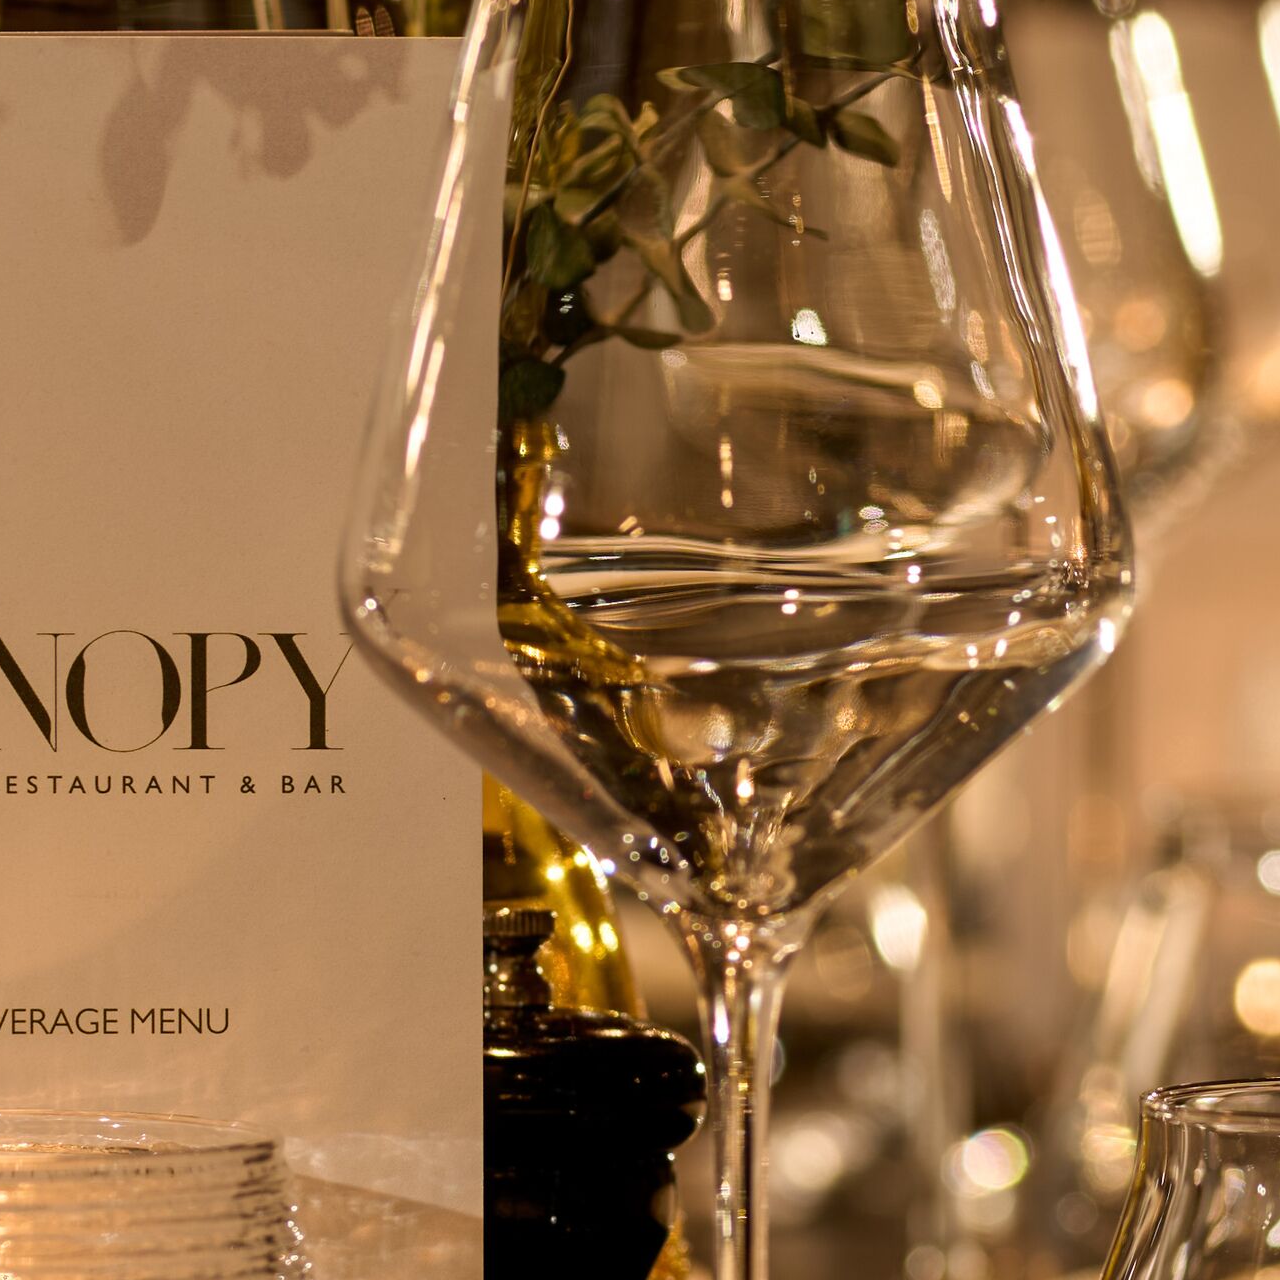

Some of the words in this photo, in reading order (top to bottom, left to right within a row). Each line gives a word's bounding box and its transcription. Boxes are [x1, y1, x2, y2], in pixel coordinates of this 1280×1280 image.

[239, 775, 256, 795] &
[281, 775, 346, 795] BAR
[130, 1007, 229, 1035] MENU
